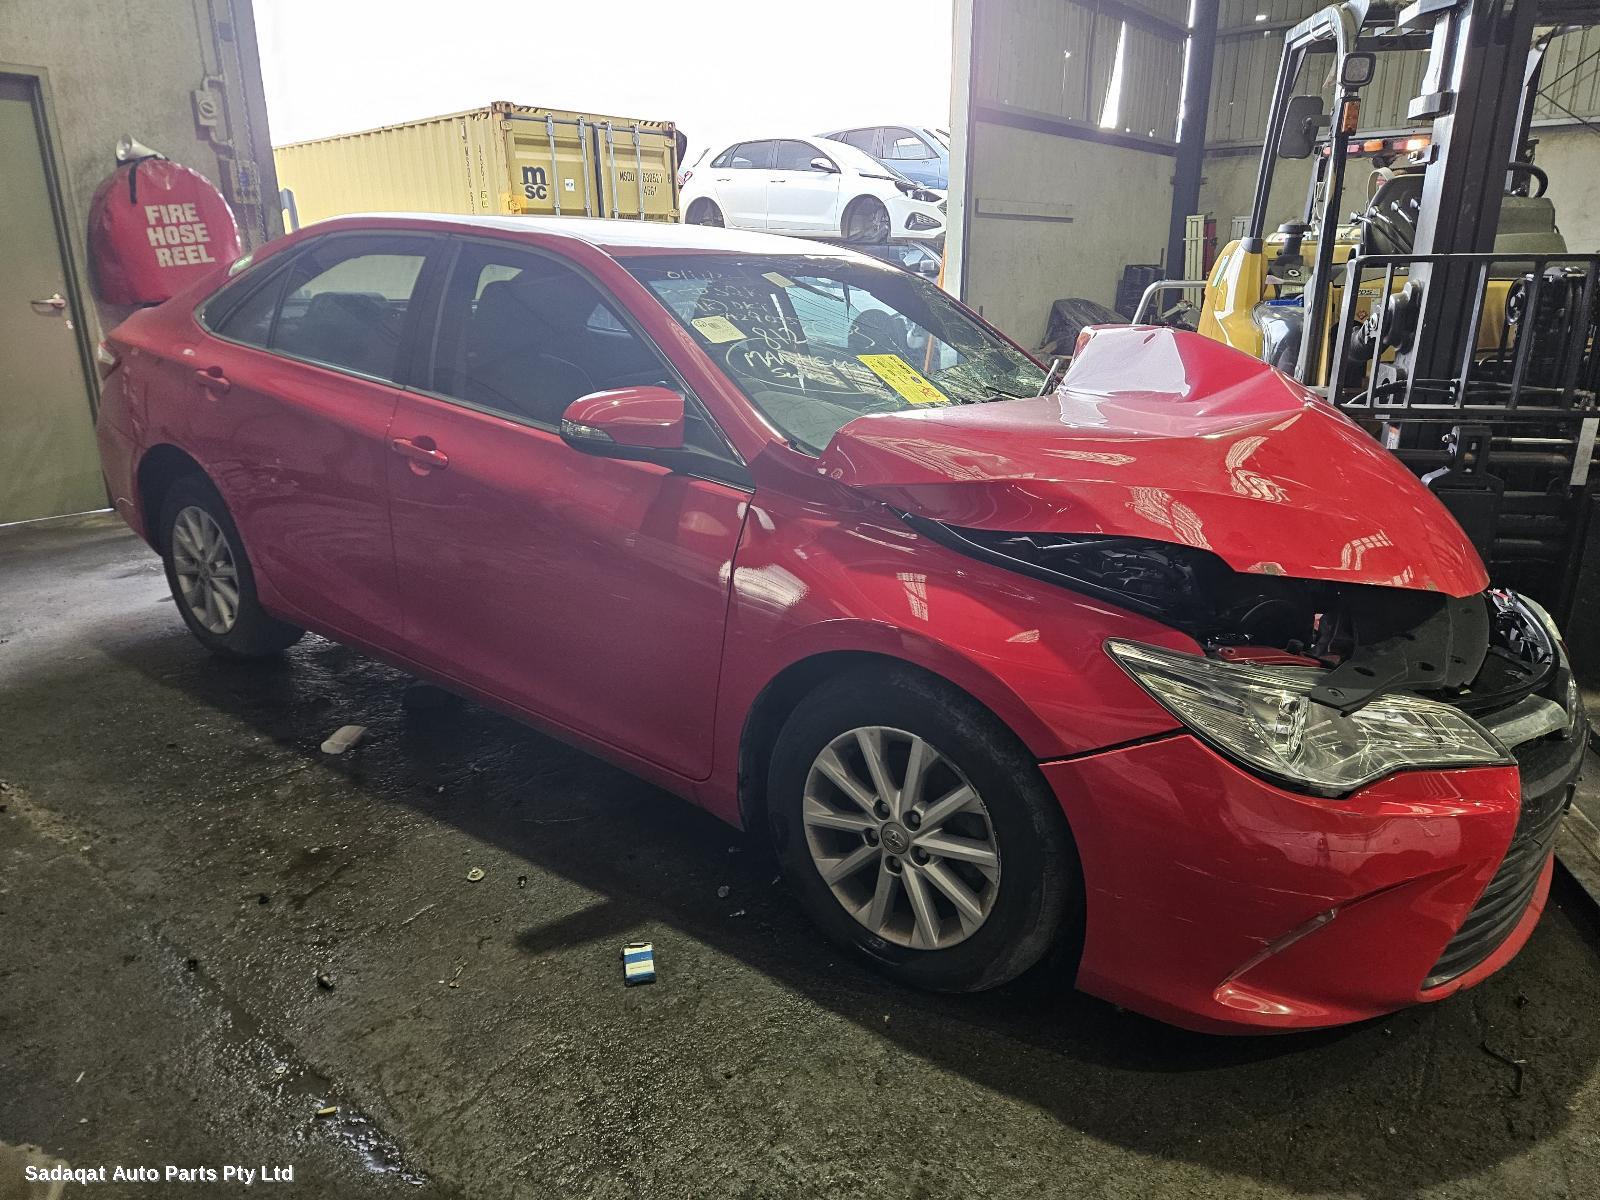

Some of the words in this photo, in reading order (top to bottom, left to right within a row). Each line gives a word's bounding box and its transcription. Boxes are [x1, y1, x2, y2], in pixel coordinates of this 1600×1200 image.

[144, 203, 199, 225] FIRE
[147, 223, 210, 246] HOSE
[156, 244, 215, 268] REEL
